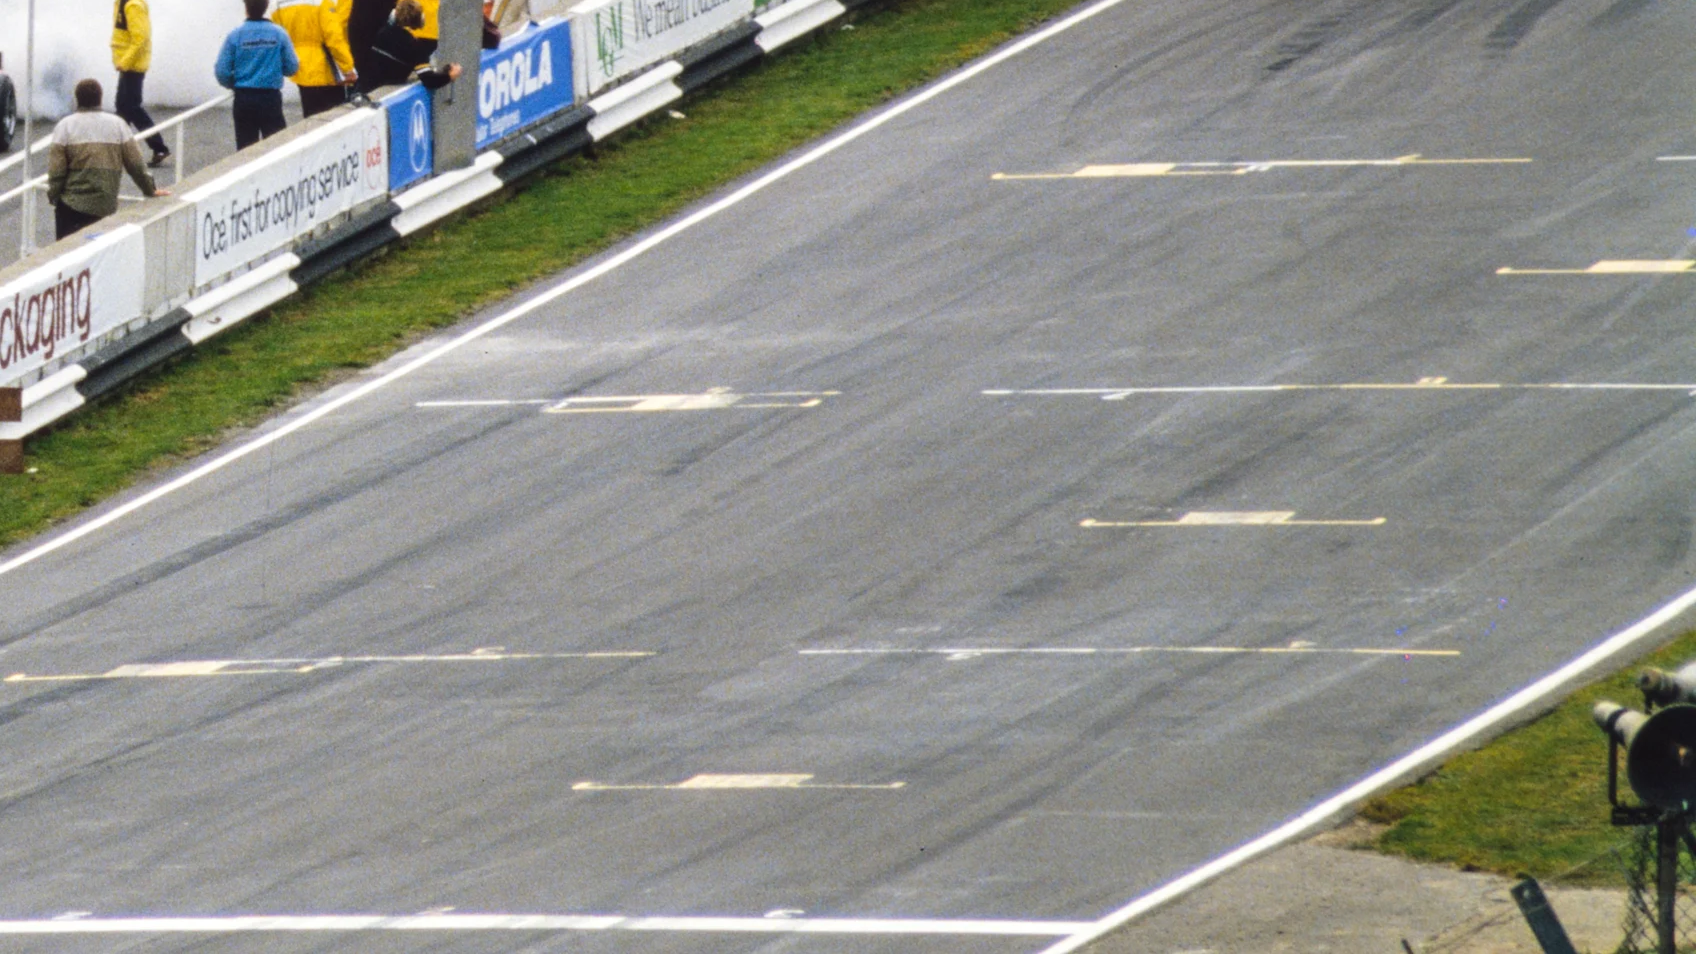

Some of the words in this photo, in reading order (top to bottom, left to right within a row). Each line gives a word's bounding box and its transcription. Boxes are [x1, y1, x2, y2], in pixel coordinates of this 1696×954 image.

[479, 41, 552, 118] OROLA
[230, 199, 252, 245] first
[254, 188, 271, 233] for
[272, 166, 317, 231] copying
[318, 144, 359, 202] service
